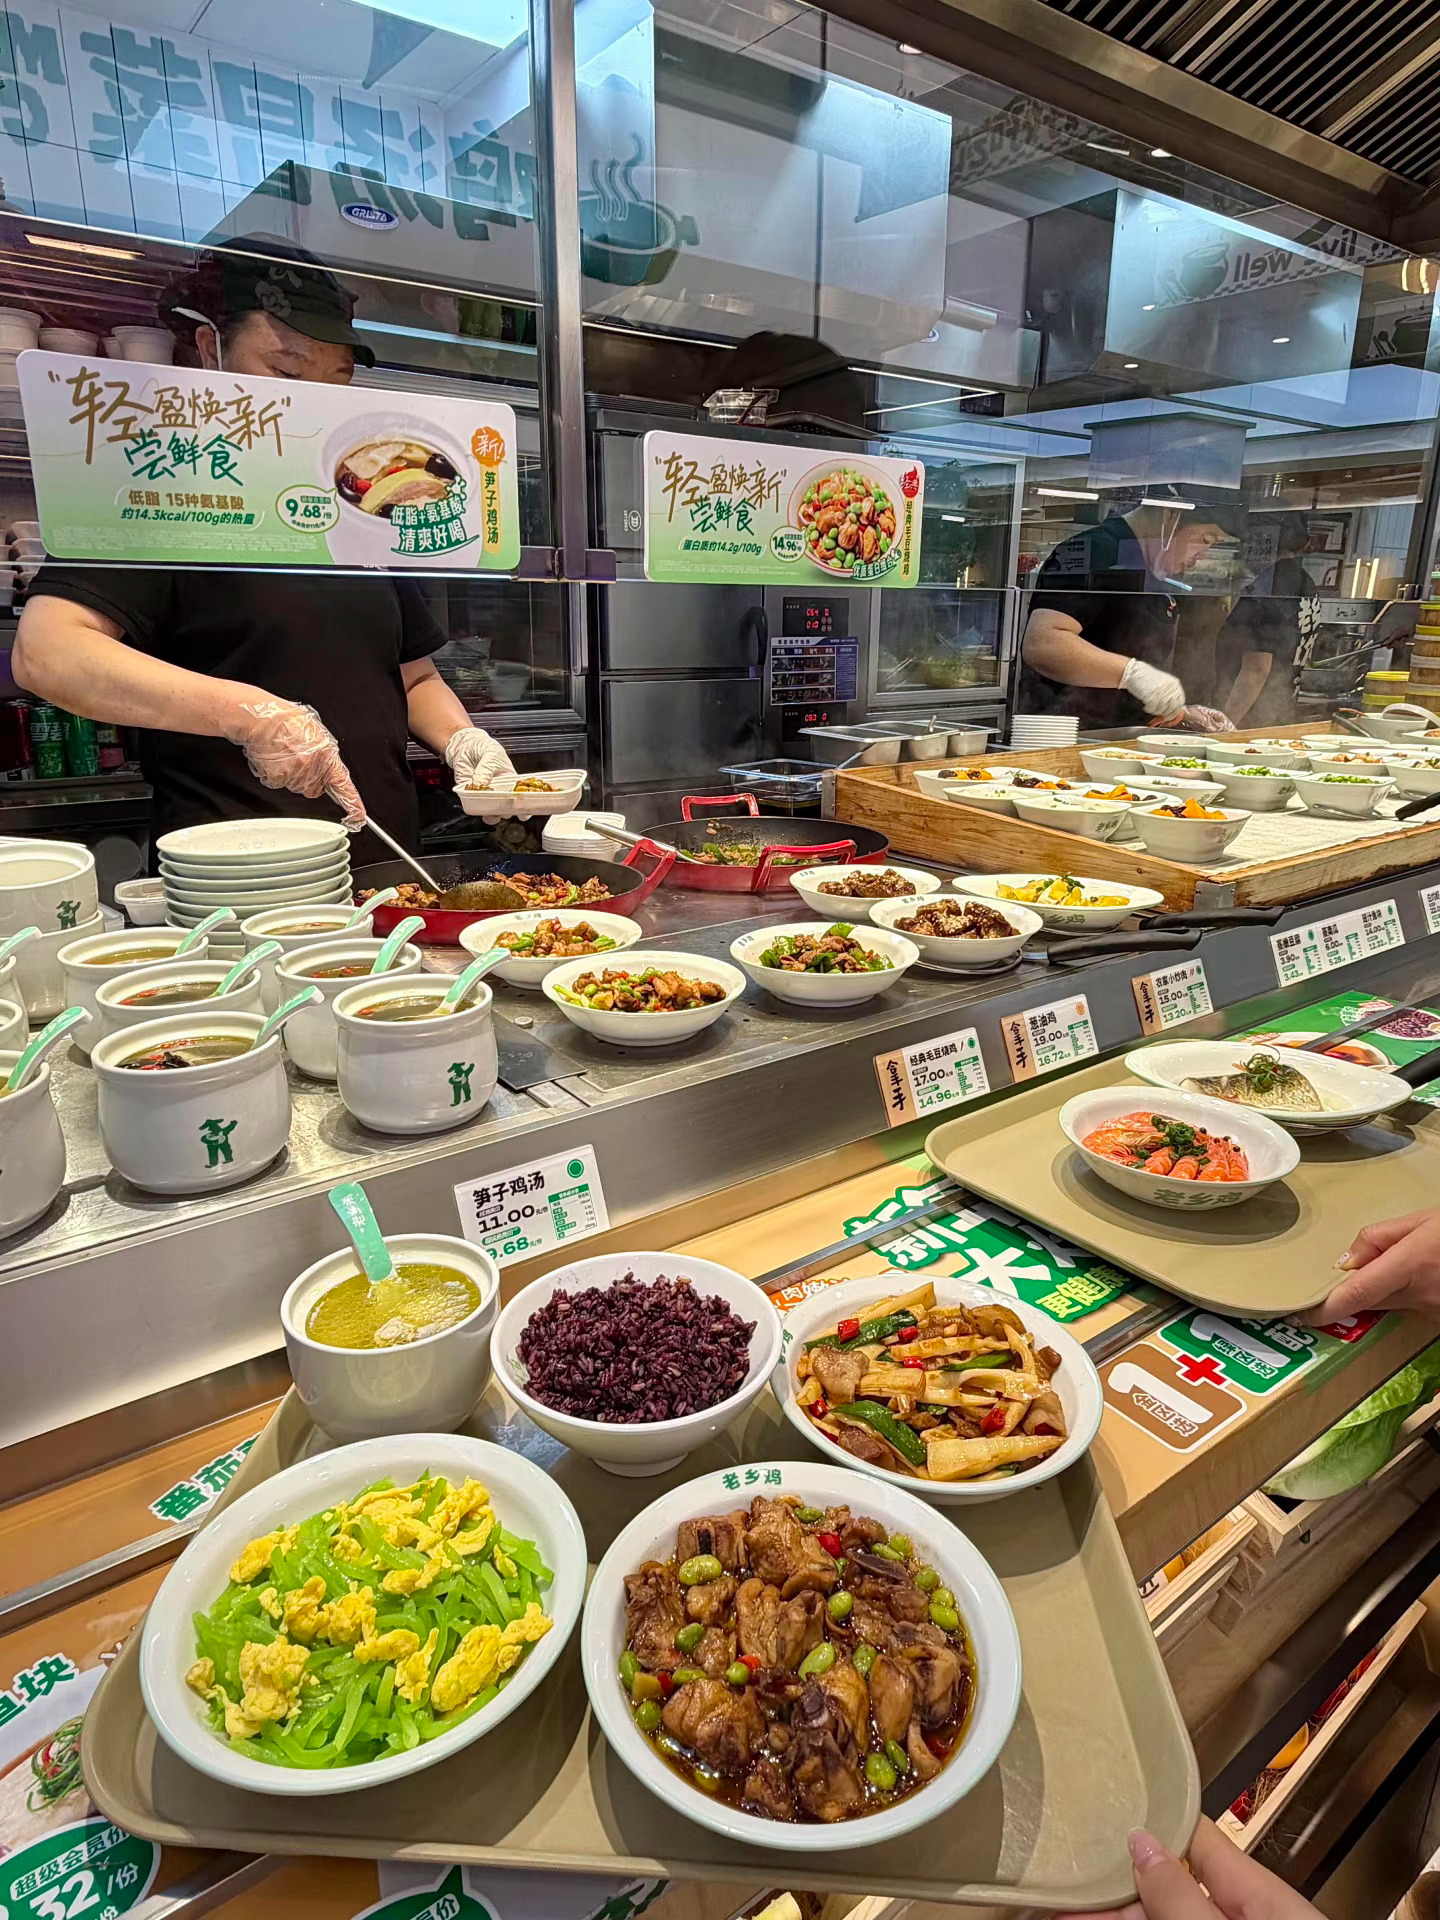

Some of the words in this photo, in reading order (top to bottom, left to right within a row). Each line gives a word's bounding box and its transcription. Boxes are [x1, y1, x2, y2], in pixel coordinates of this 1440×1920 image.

[352, 208, 387, 221] GRISTA
[124, 428, 243, 486] 尝鲜食
[128, 490, 160, 506] 低脂
[166, 492, 245, 511] 15种氨基酸
[484, 471, 499, 545] 笋子鸡汤
[121, 507, 255, 525] 约14.3kcal/100g的热量
[391, 498, 467, 527] 低脂+氨基酸
[690, 495, 755, 536] 尝鲜食
[400, 520, 466, 552] 清爽好喝
[683, 539, 762, 555] 蛋白质约14.2g/100g
[30, 721, 70, 741] 雪碧
[1040, 912, 1086, 924] 乡鸡
[1155, 969, 1188, 988] 农家小炒肉
[1028, 1011, 1057, 1031] 葱油鸡
[909, 1042, 958, 1066] 经典毛豆烧鸡
[472, 1171, 545, 1209] 笋子鸡汤
[1154, 1188, 1243, 1207] 老乡鸡
[1035, 1264, 1131, 1319] 更健康
[151, 1434, 259, 1521] 番茄
[722, 1468, 782, 1491] 老乡鸡
[15, 1826, 131, 1898] 超级会员价
